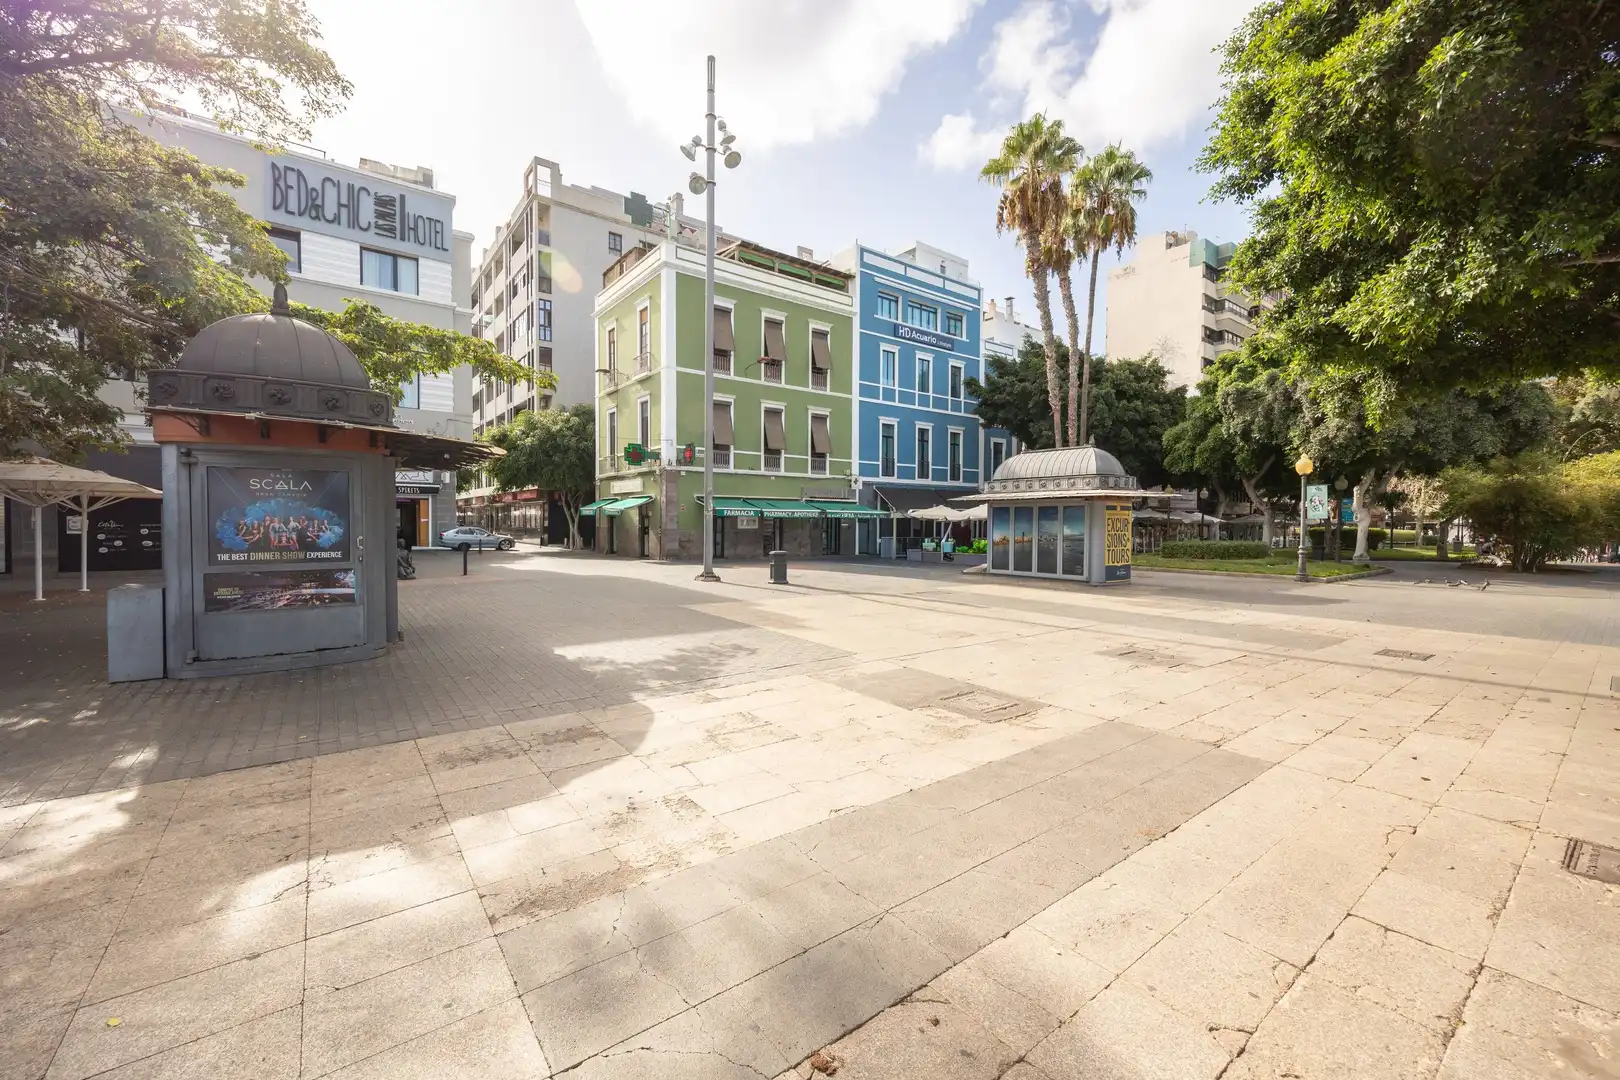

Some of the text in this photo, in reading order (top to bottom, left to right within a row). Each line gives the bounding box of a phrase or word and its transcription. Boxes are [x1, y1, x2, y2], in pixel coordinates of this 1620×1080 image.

[407, 211, 449, 251] HOTEL
[899, 326, 911, 338] HD
[911, 330, 937, 344] Acuario
[249, 478, 313, 491] SCALA
[723, 509, 755, 517] FARMACIA
[217, 551, 343, 561] THE BEST DINNER SHOW EXPERIENCE
[1107, 549, 1130, 564] TOURS
